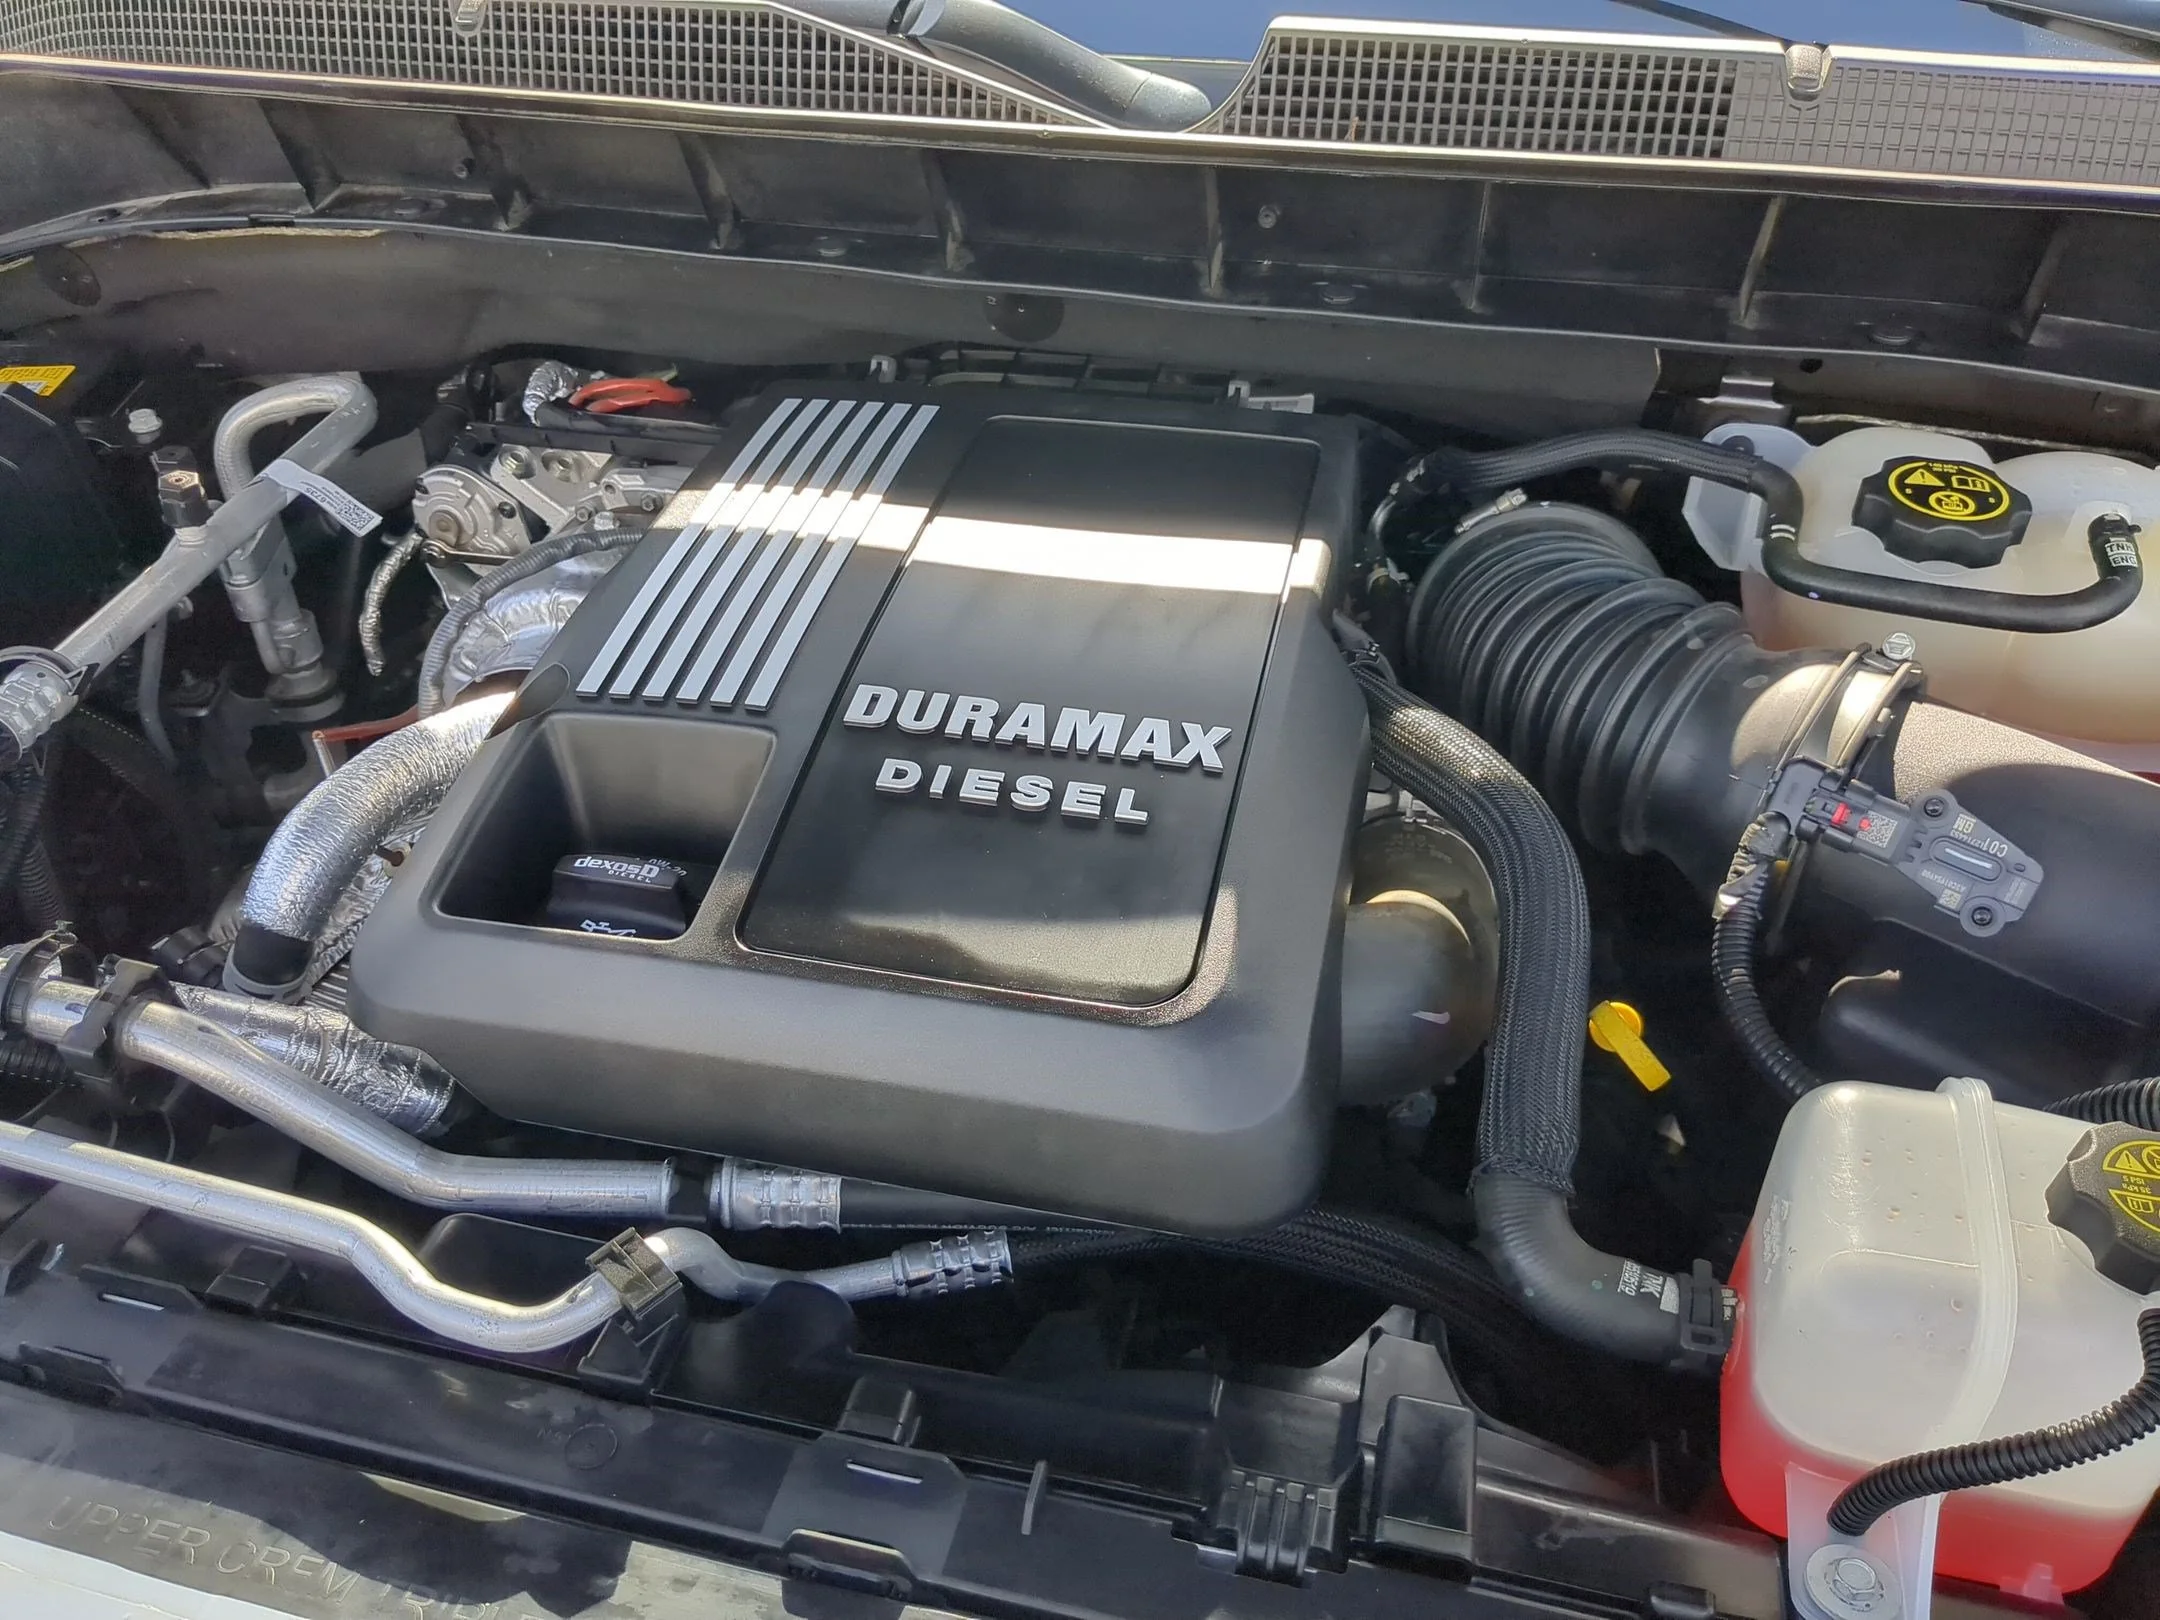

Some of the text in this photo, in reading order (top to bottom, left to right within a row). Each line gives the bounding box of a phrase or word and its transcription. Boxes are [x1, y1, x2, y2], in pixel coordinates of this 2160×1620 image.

[843, 683, 1231, 774] DURAMAX
[875, 758, 1149, 825] DIESEL
[1952, 815, 1974, 834] GM
[48, 1496, 211, 1565] UPPER
